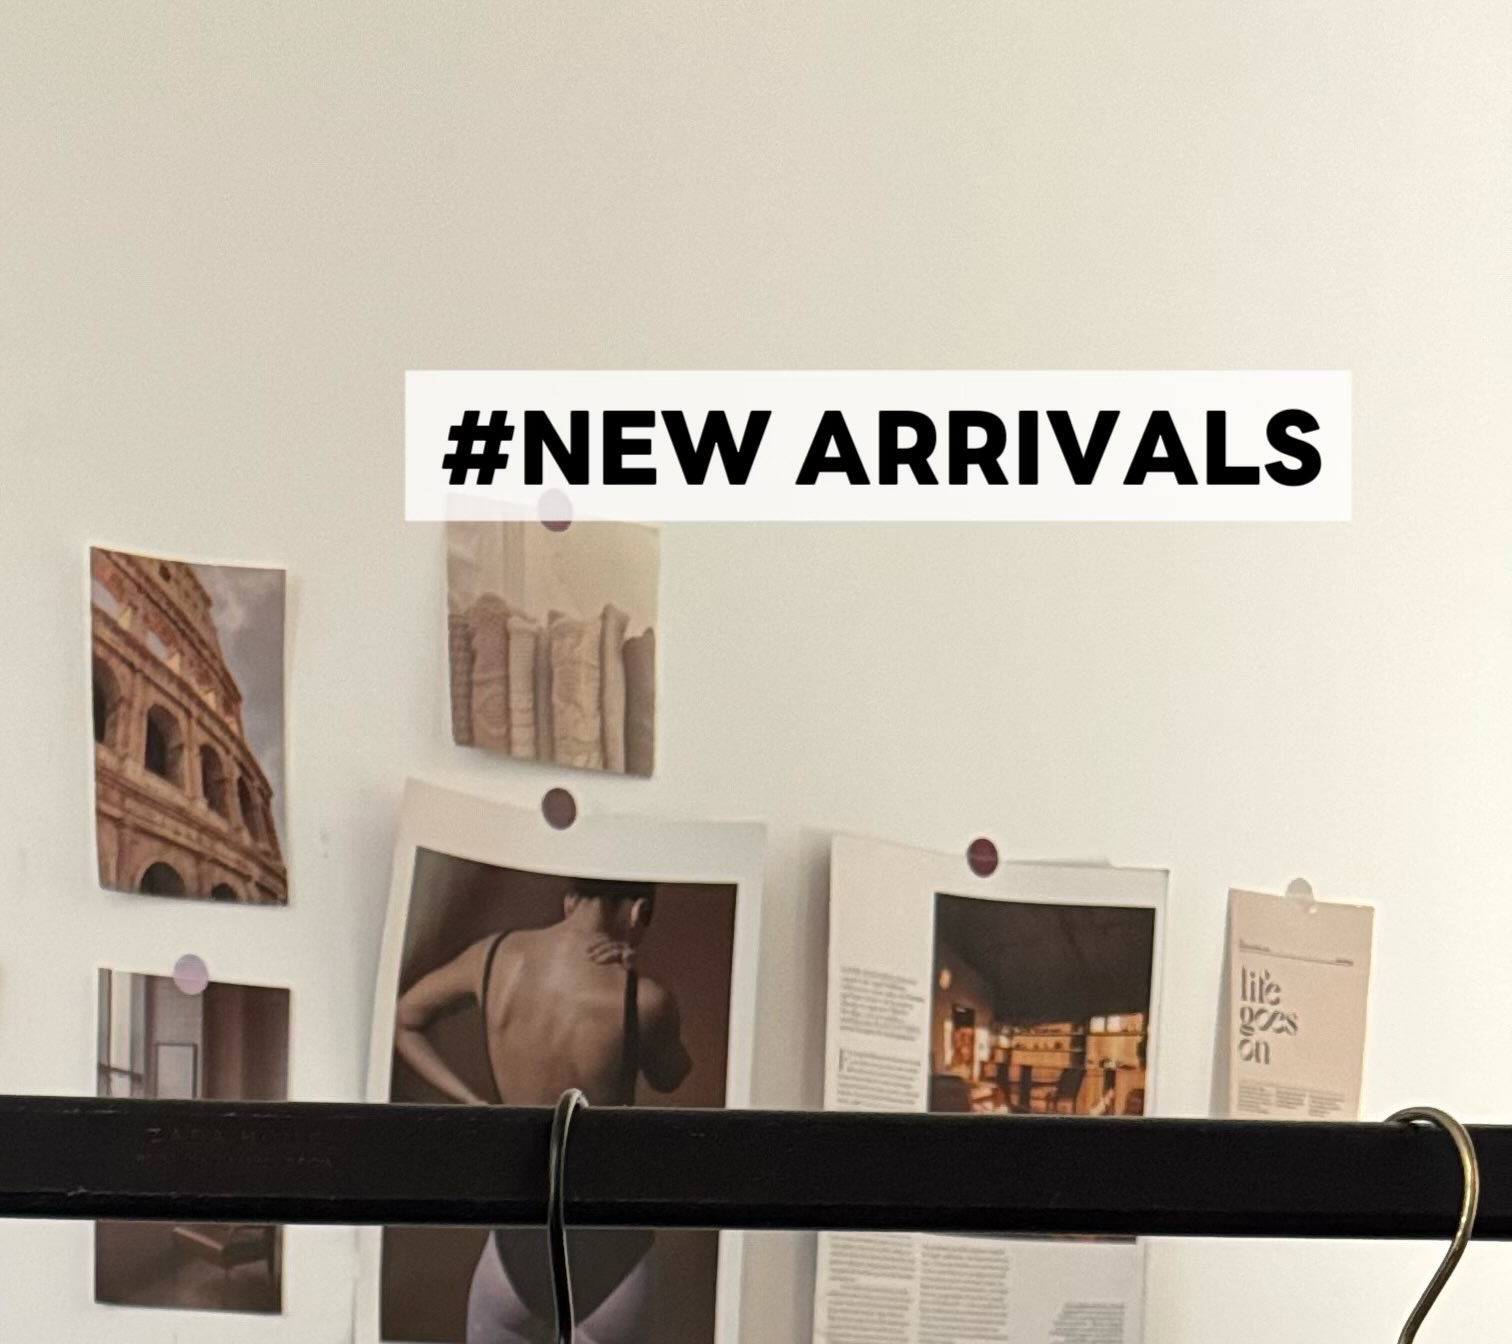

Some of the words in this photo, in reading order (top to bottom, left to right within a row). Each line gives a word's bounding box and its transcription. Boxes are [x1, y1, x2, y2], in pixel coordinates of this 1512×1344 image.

[1240, 965, 1282, 1006] life
[1239, 1006, 1299, 1037] goes
[1238, 1039, 1271, 1065] on
